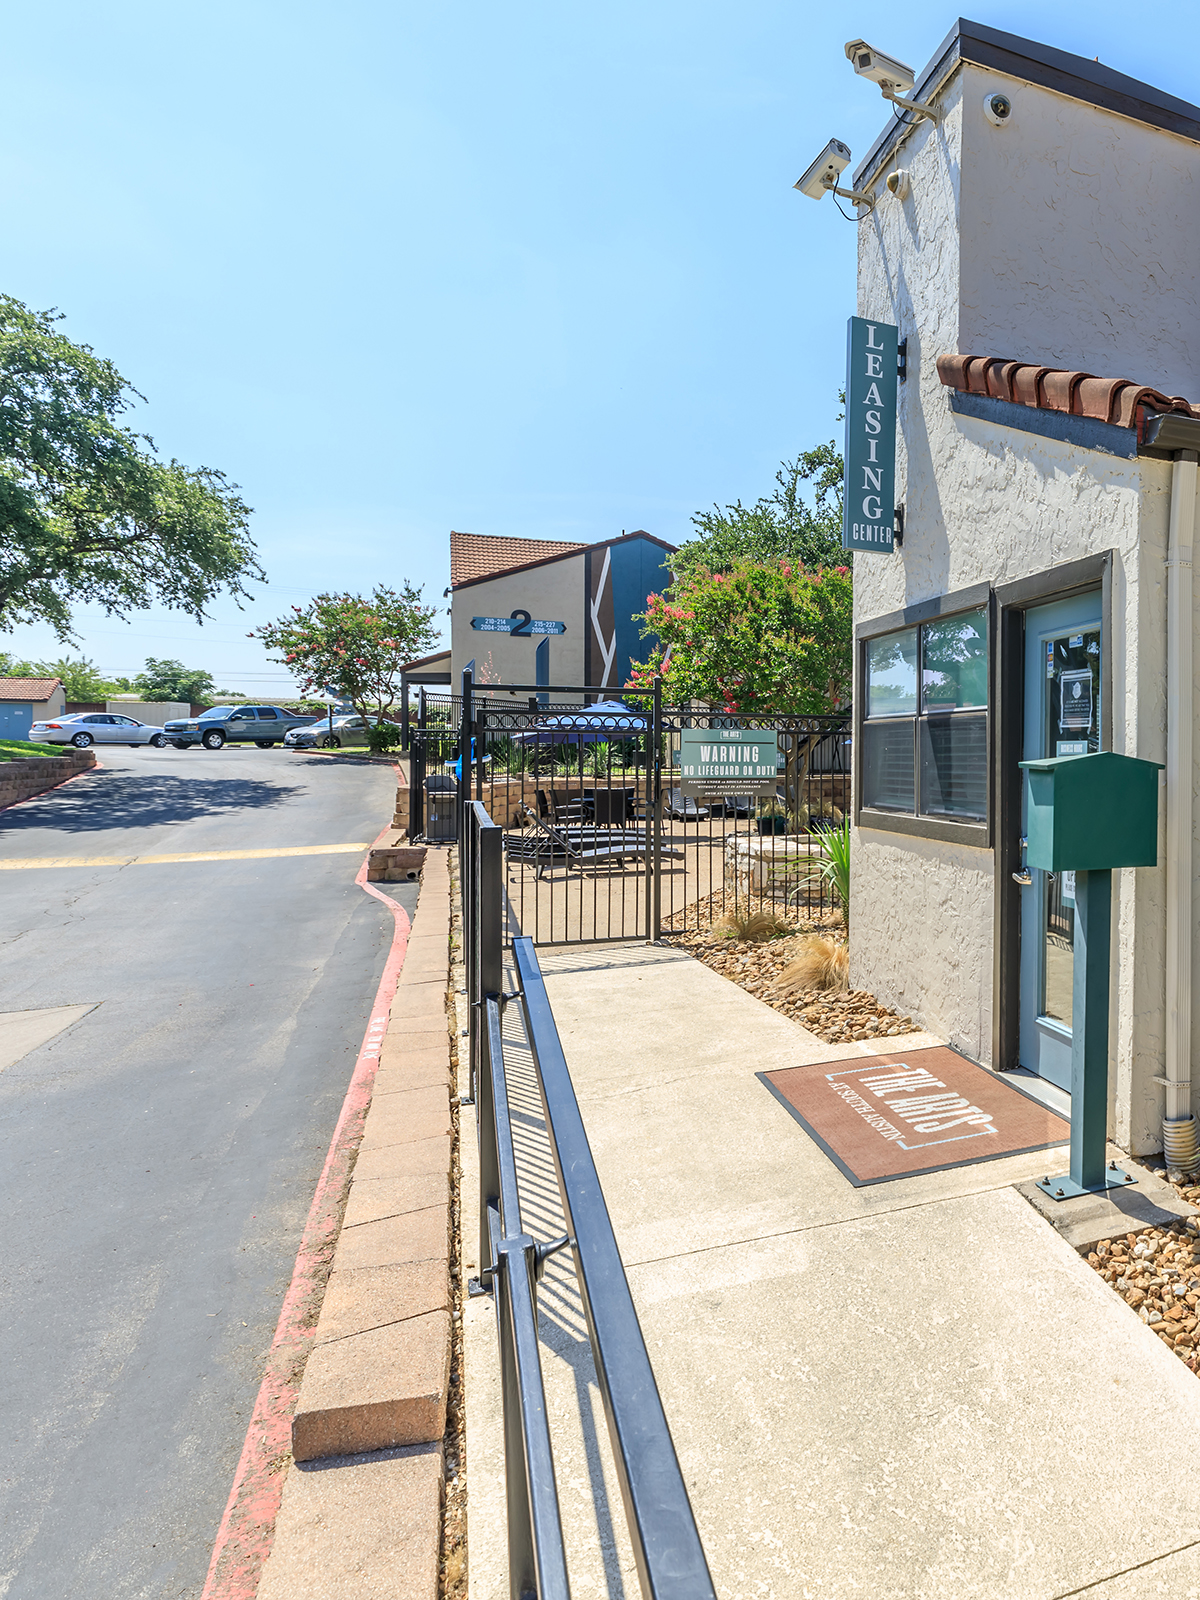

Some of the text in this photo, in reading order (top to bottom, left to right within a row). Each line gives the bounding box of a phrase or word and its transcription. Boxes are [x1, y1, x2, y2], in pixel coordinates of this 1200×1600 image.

[861, 324, 885, 520] LEASING
[852, 521, 892, 545] CENTER
[480, 624, 511, 632] 2004-2005
[510, 609, 531, 637] 2
[730, 730, 739, 738] ARTS
[700, 745, 759, 763] WARNING
[684, 765, 775, 776] NO LIFEGUARD ON DUTY
[827, 1082, 906, 1141] AT SOUTH AUSTIN
[857, 1067, 994, 1133] THE ARTS
